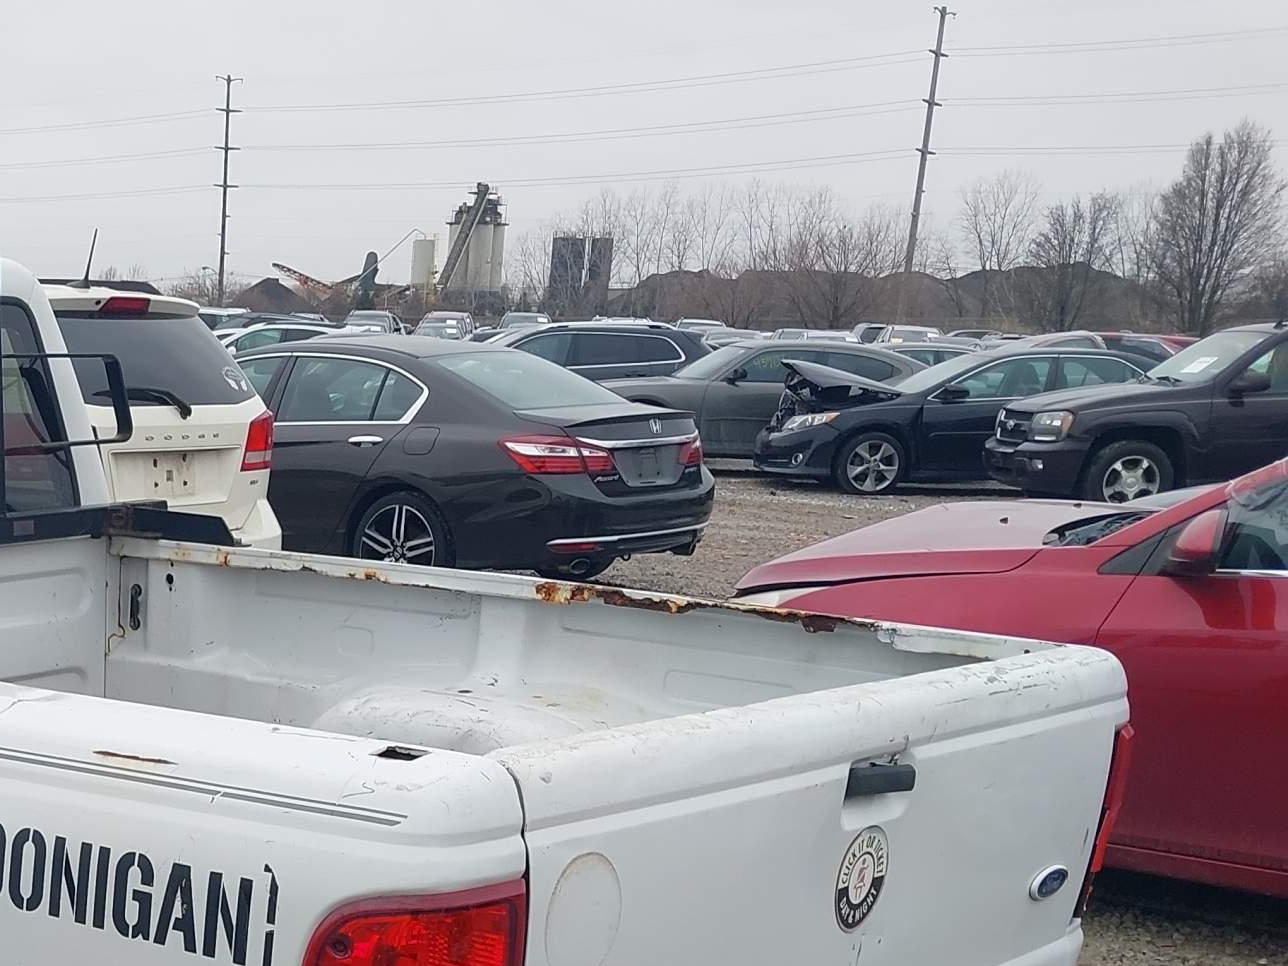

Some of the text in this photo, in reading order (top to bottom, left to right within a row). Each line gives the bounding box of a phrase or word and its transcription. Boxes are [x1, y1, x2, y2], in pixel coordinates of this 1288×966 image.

[841, 834, 885, 884] CLICK IT OR TICKET
[840, 896, 850, 921] DAY
[855, 887, 877, 923] NIGHT
